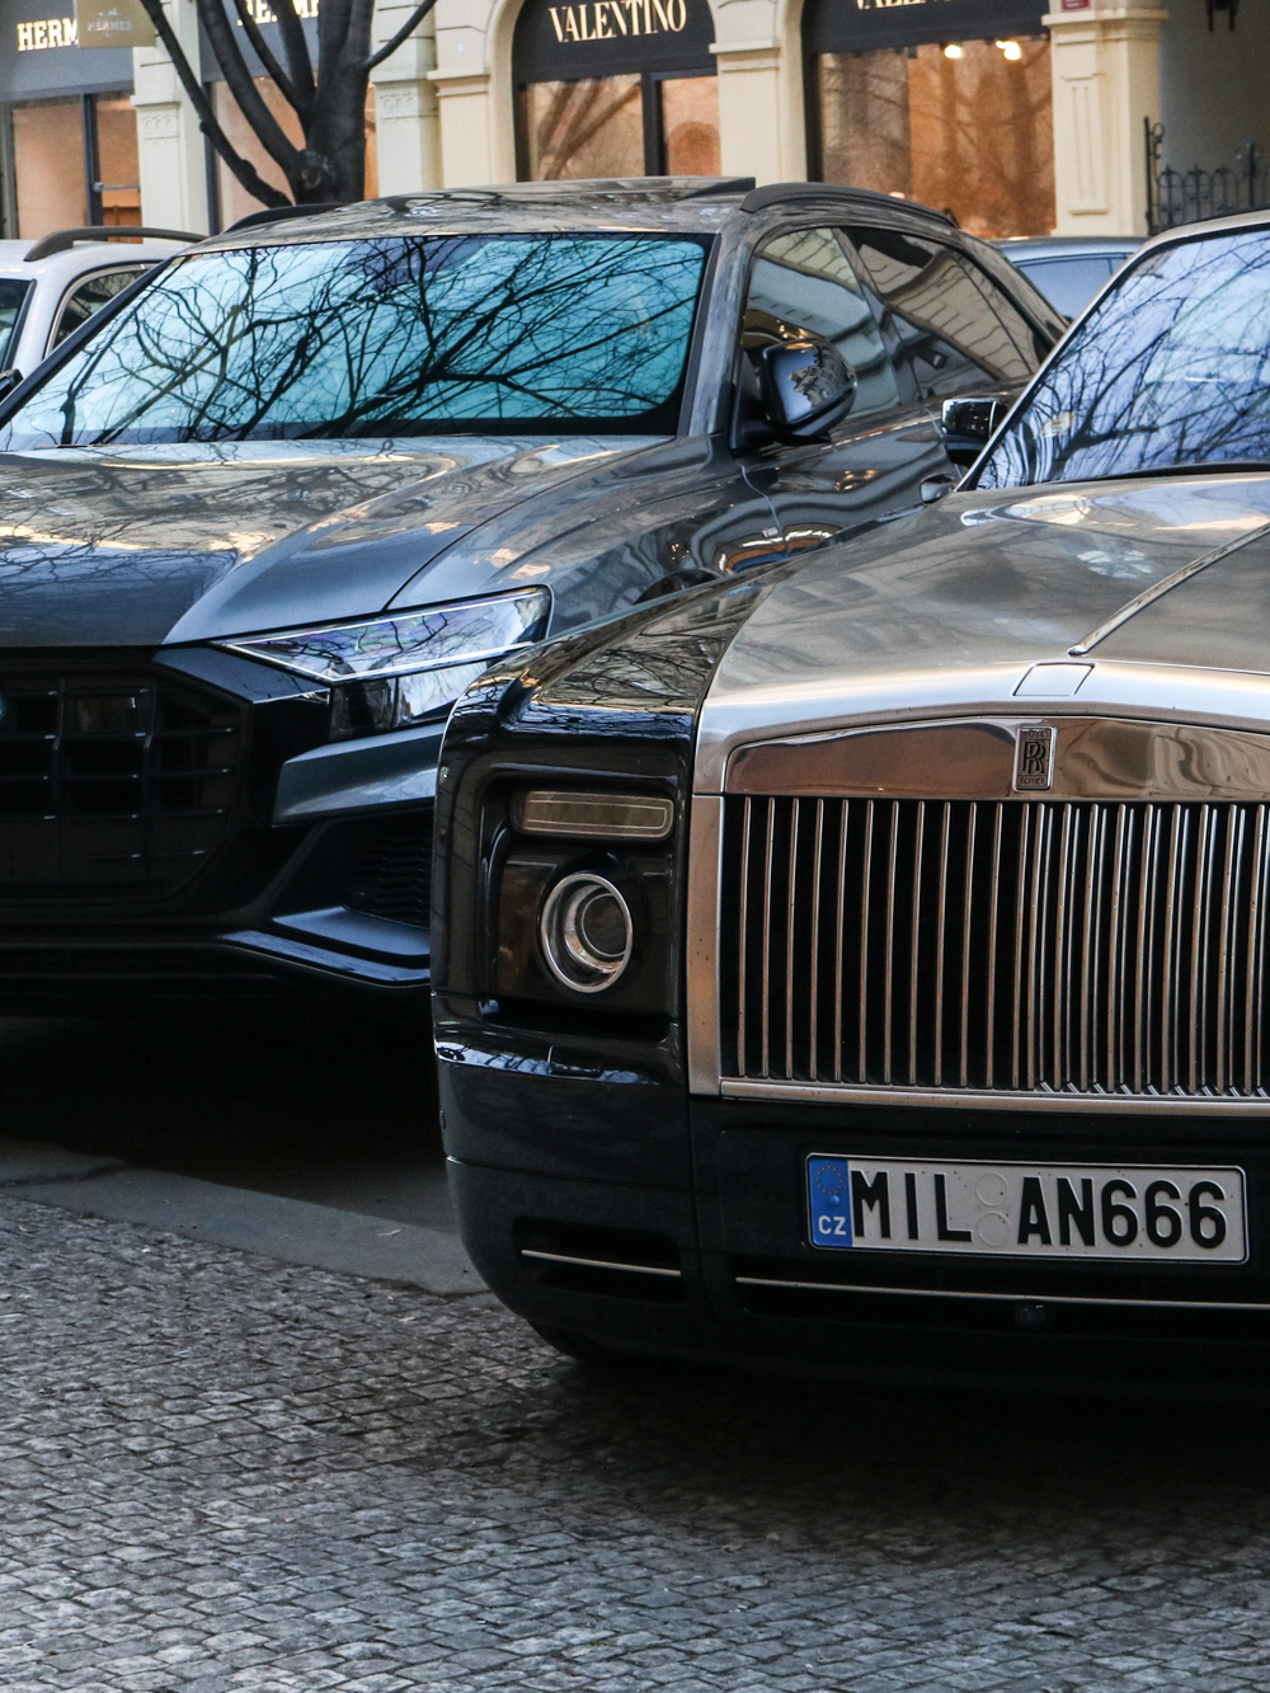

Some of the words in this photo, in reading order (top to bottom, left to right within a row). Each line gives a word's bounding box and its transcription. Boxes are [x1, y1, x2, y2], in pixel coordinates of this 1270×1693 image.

[17, 18, 78, 51] HERM
[548, 0, 687, 42] VALENTINO
[1022, 741, 1046, 774] RR
[1019, 776, 1045, 786] ROYCE
[818, 1215, 846, 1235] CZ
[850, 1170, 972, 1242] MIL
[1018, 1177, 1226, 1249] AN666
